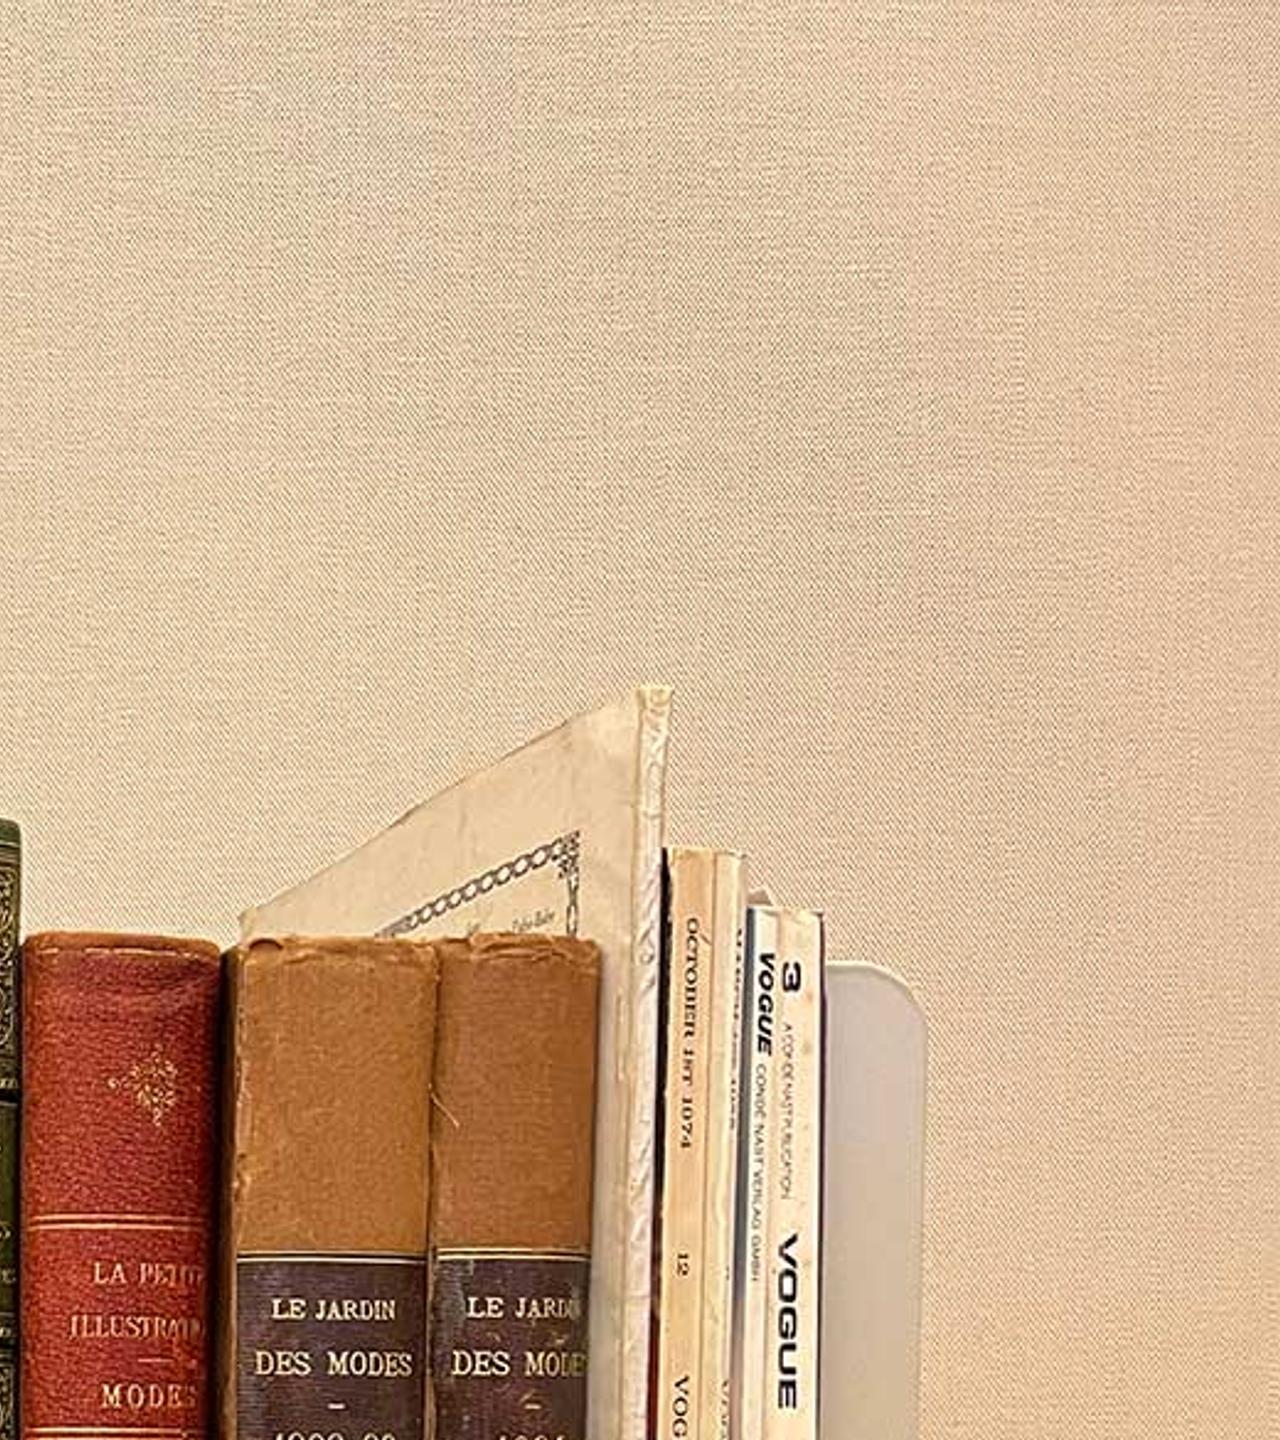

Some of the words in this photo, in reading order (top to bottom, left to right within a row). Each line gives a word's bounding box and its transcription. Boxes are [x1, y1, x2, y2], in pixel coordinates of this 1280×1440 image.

[781, 960, 802, 994] 3
[756, 952, 776, 1057] VOGUE
[93, 1262, 127, 1285] LA
[271, 1299, 306, 1321] LE
[315, 1299, 396, 1322] JARDIN
[466, 1296, 504, 1320] LE
[777, 1232, 799, 1410] VOGUE
[255, 1350, 312, 1376] DES
[326, 1351, 414, 1378] MODES
[452, 1350, 511, 1378] DES
